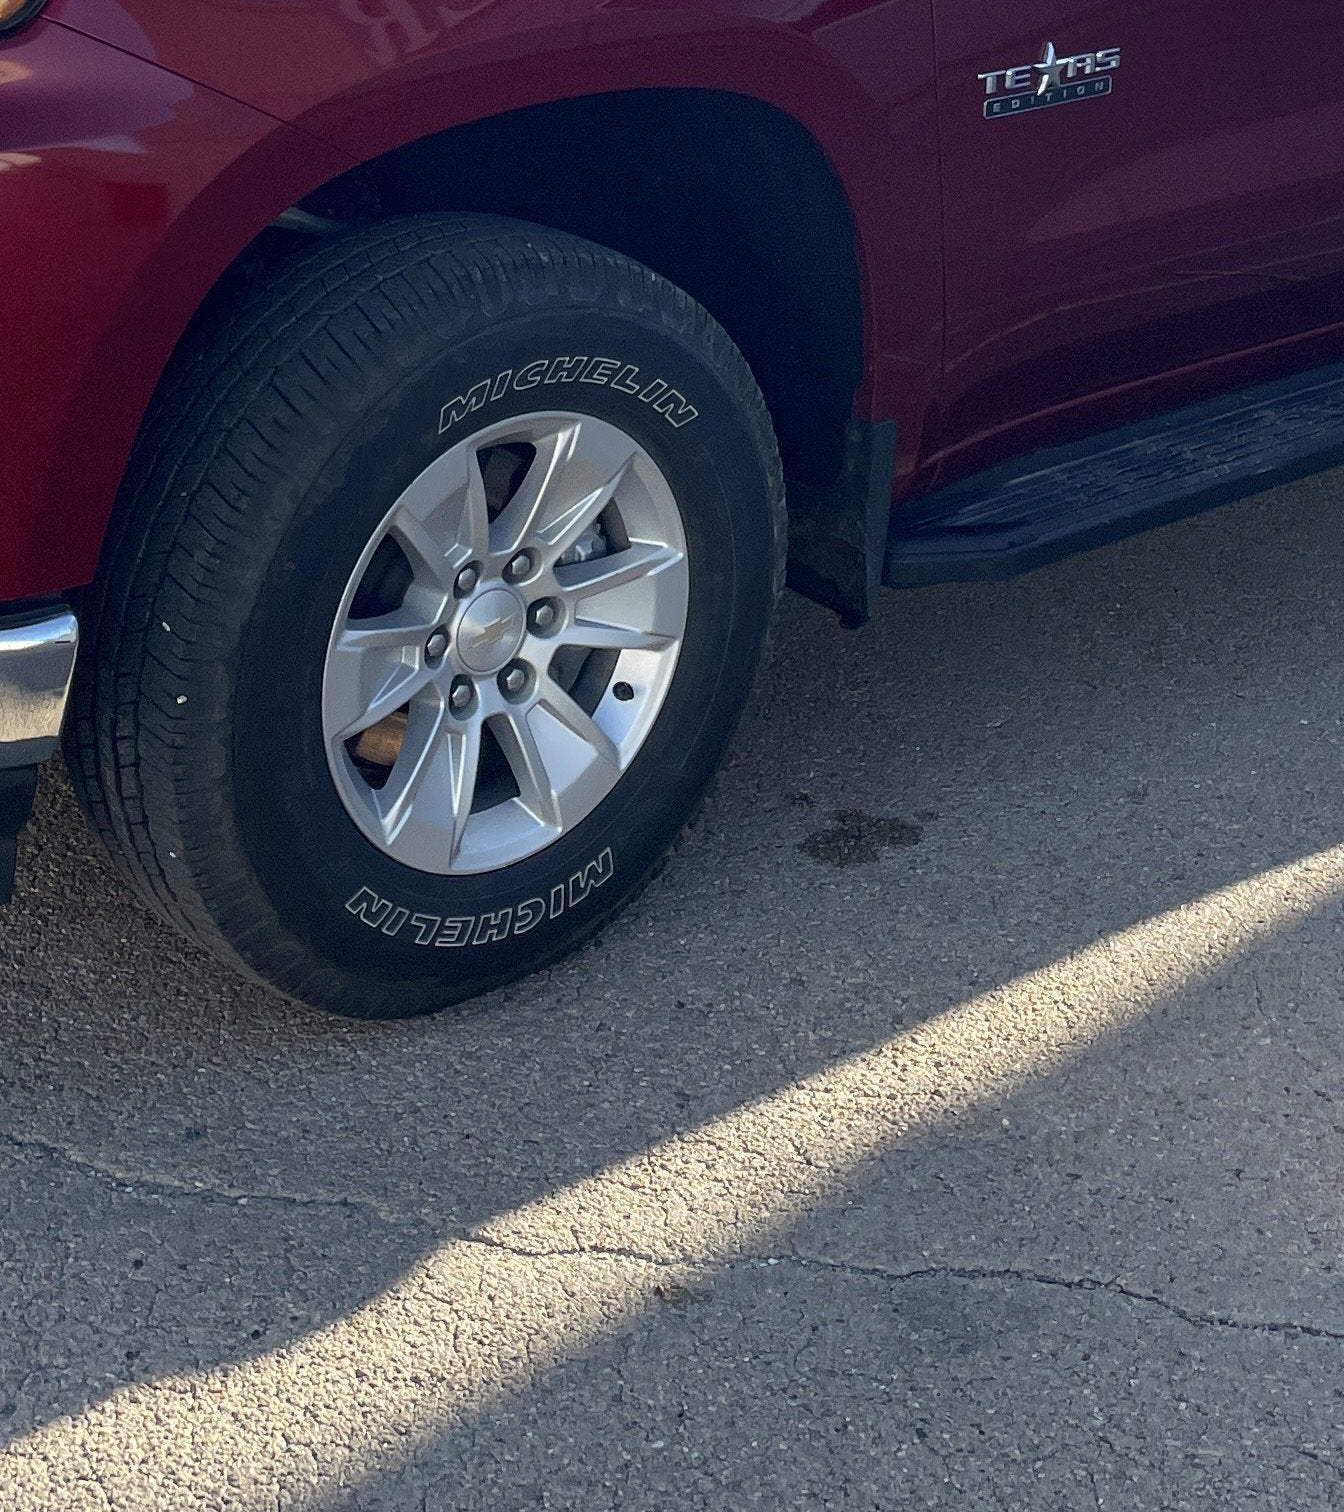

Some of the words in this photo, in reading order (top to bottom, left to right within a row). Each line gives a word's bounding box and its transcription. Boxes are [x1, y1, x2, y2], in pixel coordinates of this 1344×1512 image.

[977, 40, 1121, 96] TEXAS
[991, 80, 1105, 113] EDITION
[438, 355, 699, 435] MICHELIN
[344, 846, 614, 947] MICHELIN
